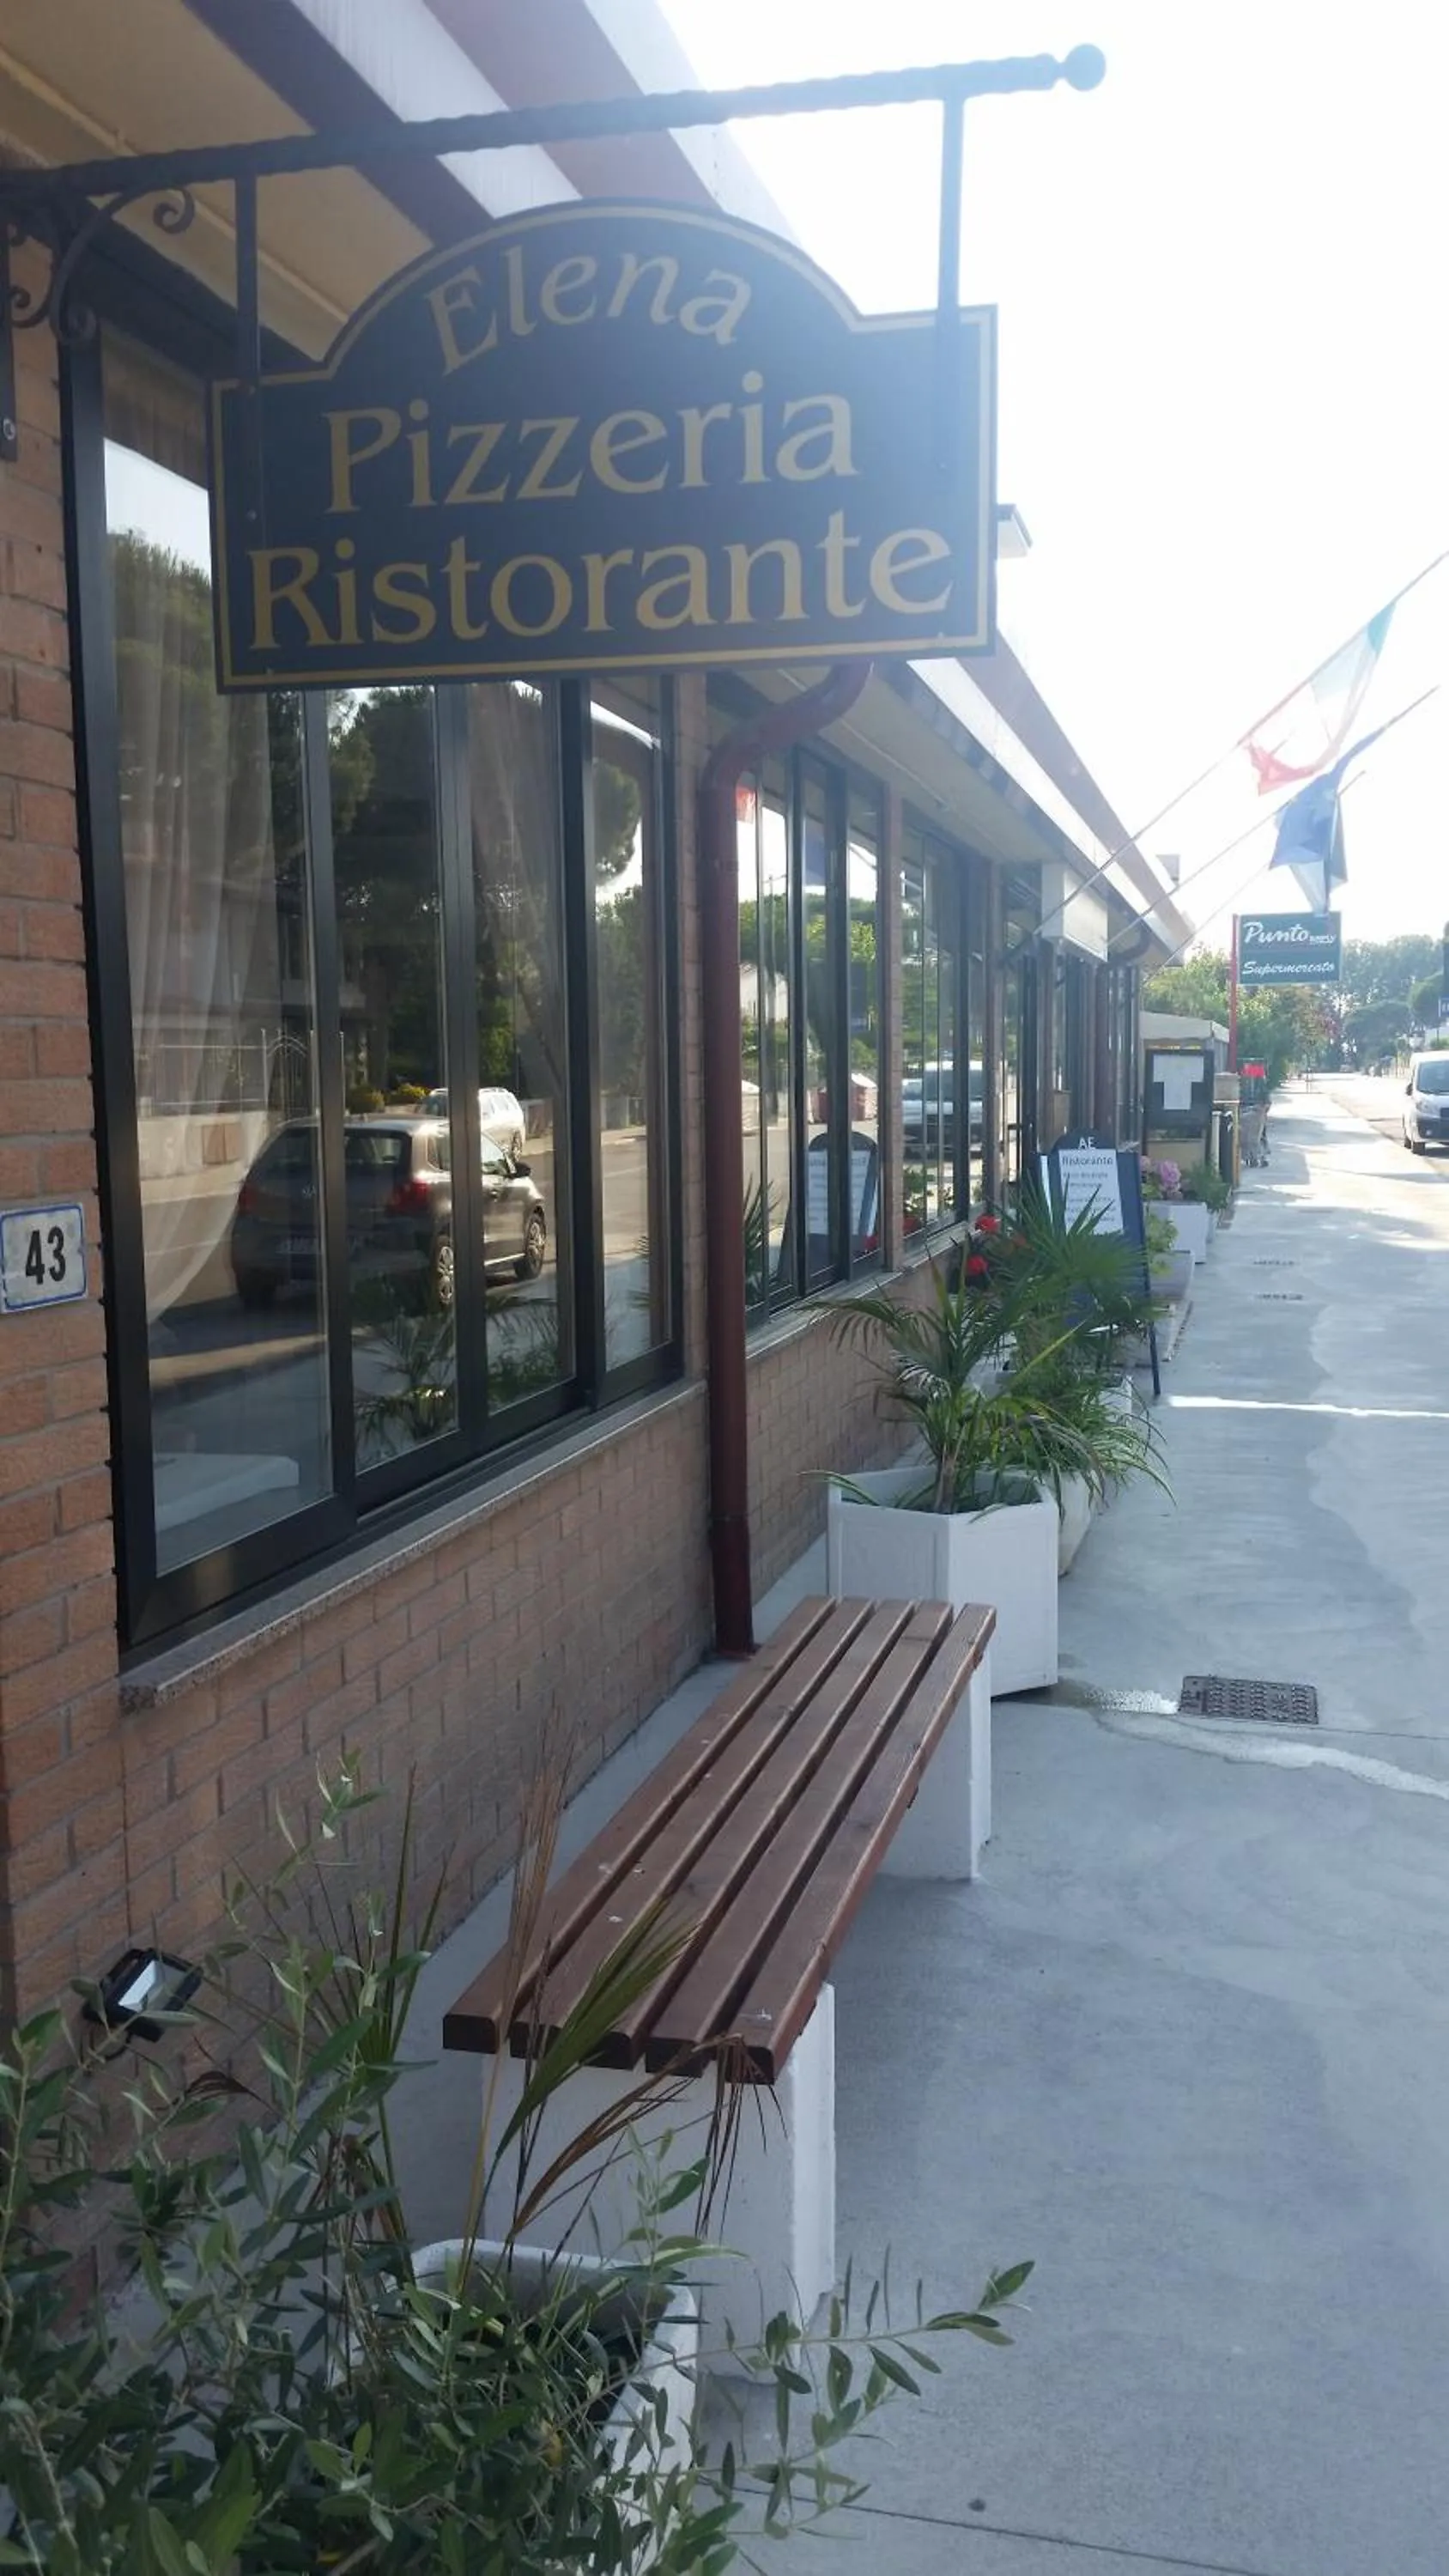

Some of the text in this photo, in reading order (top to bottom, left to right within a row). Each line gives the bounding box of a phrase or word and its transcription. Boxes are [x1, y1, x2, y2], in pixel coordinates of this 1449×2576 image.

[424, 246, 753, 375] Elena
[324, 370, 860, 515] Pizzeria
[248, 510, 955, 651] Ristorante
[1243, 921, 1308, 943] Punto
[25, 1225, 66, 1285] 43
